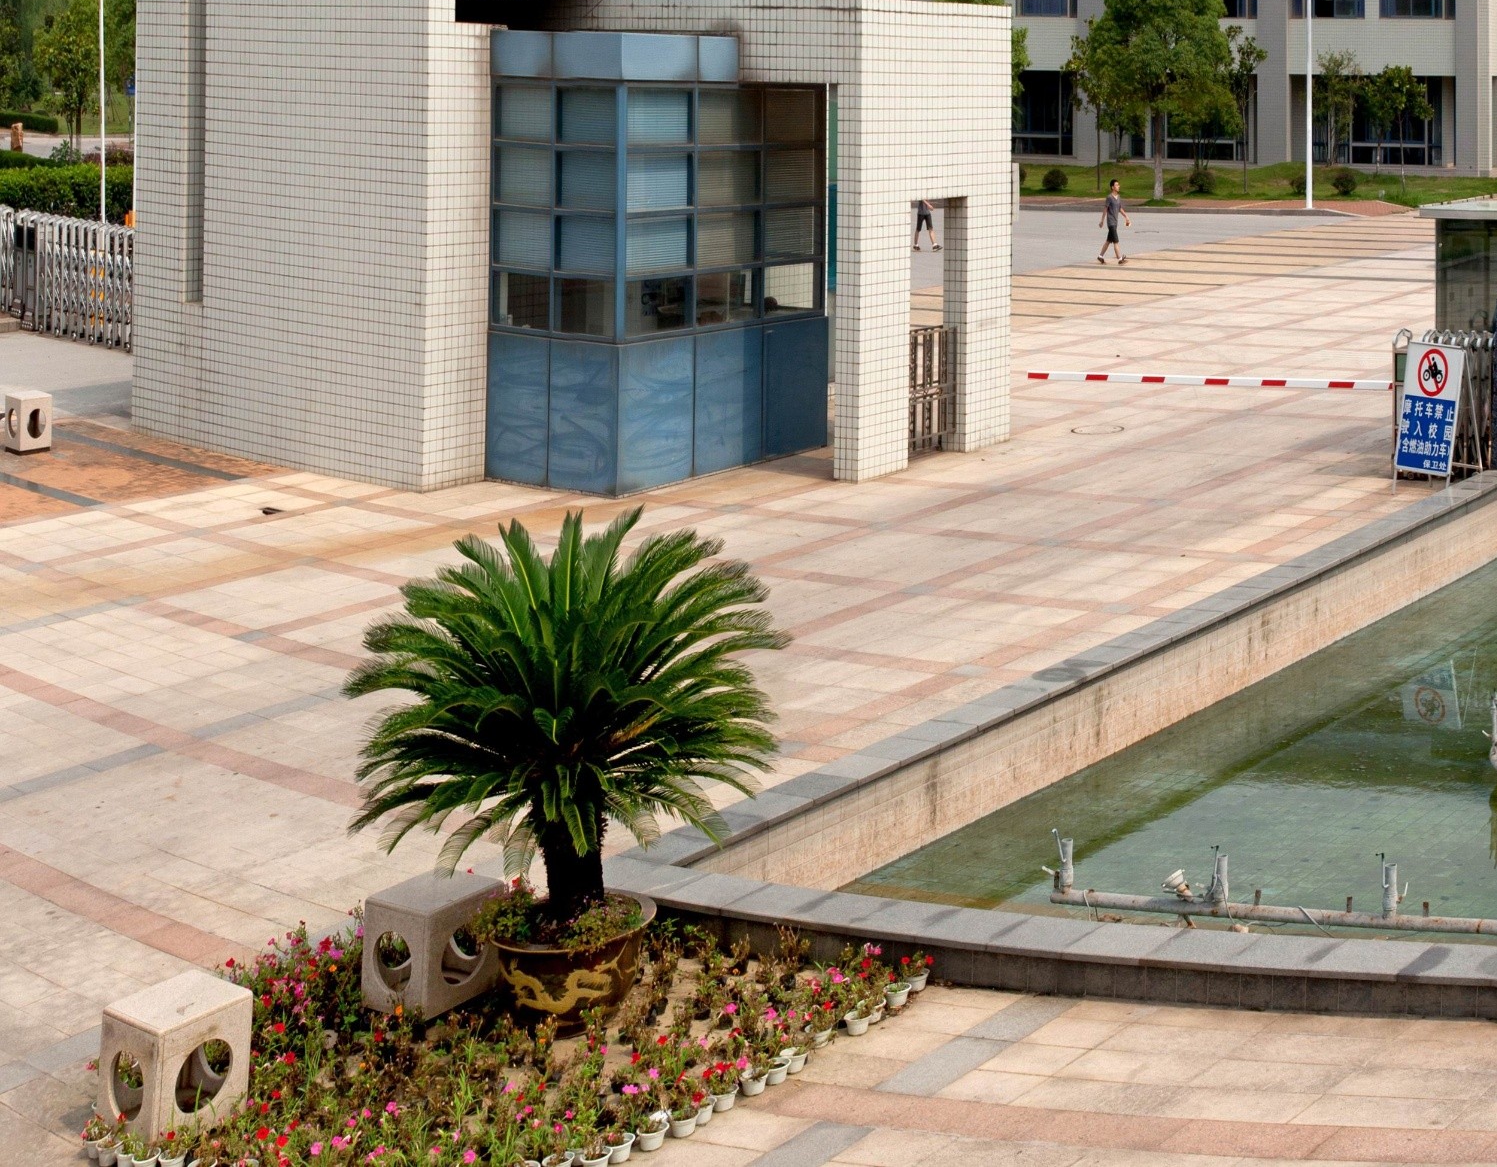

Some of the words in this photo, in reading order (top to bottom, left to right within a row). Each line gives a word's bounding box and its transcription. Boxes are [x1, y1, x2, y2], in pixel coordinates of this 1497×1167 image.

[1404, 399, 1454, 422] 摩托车禁止
[1401, 419, 1452, 441] 驶入校园
[1423, 459, 1447, 471] 保卫处
